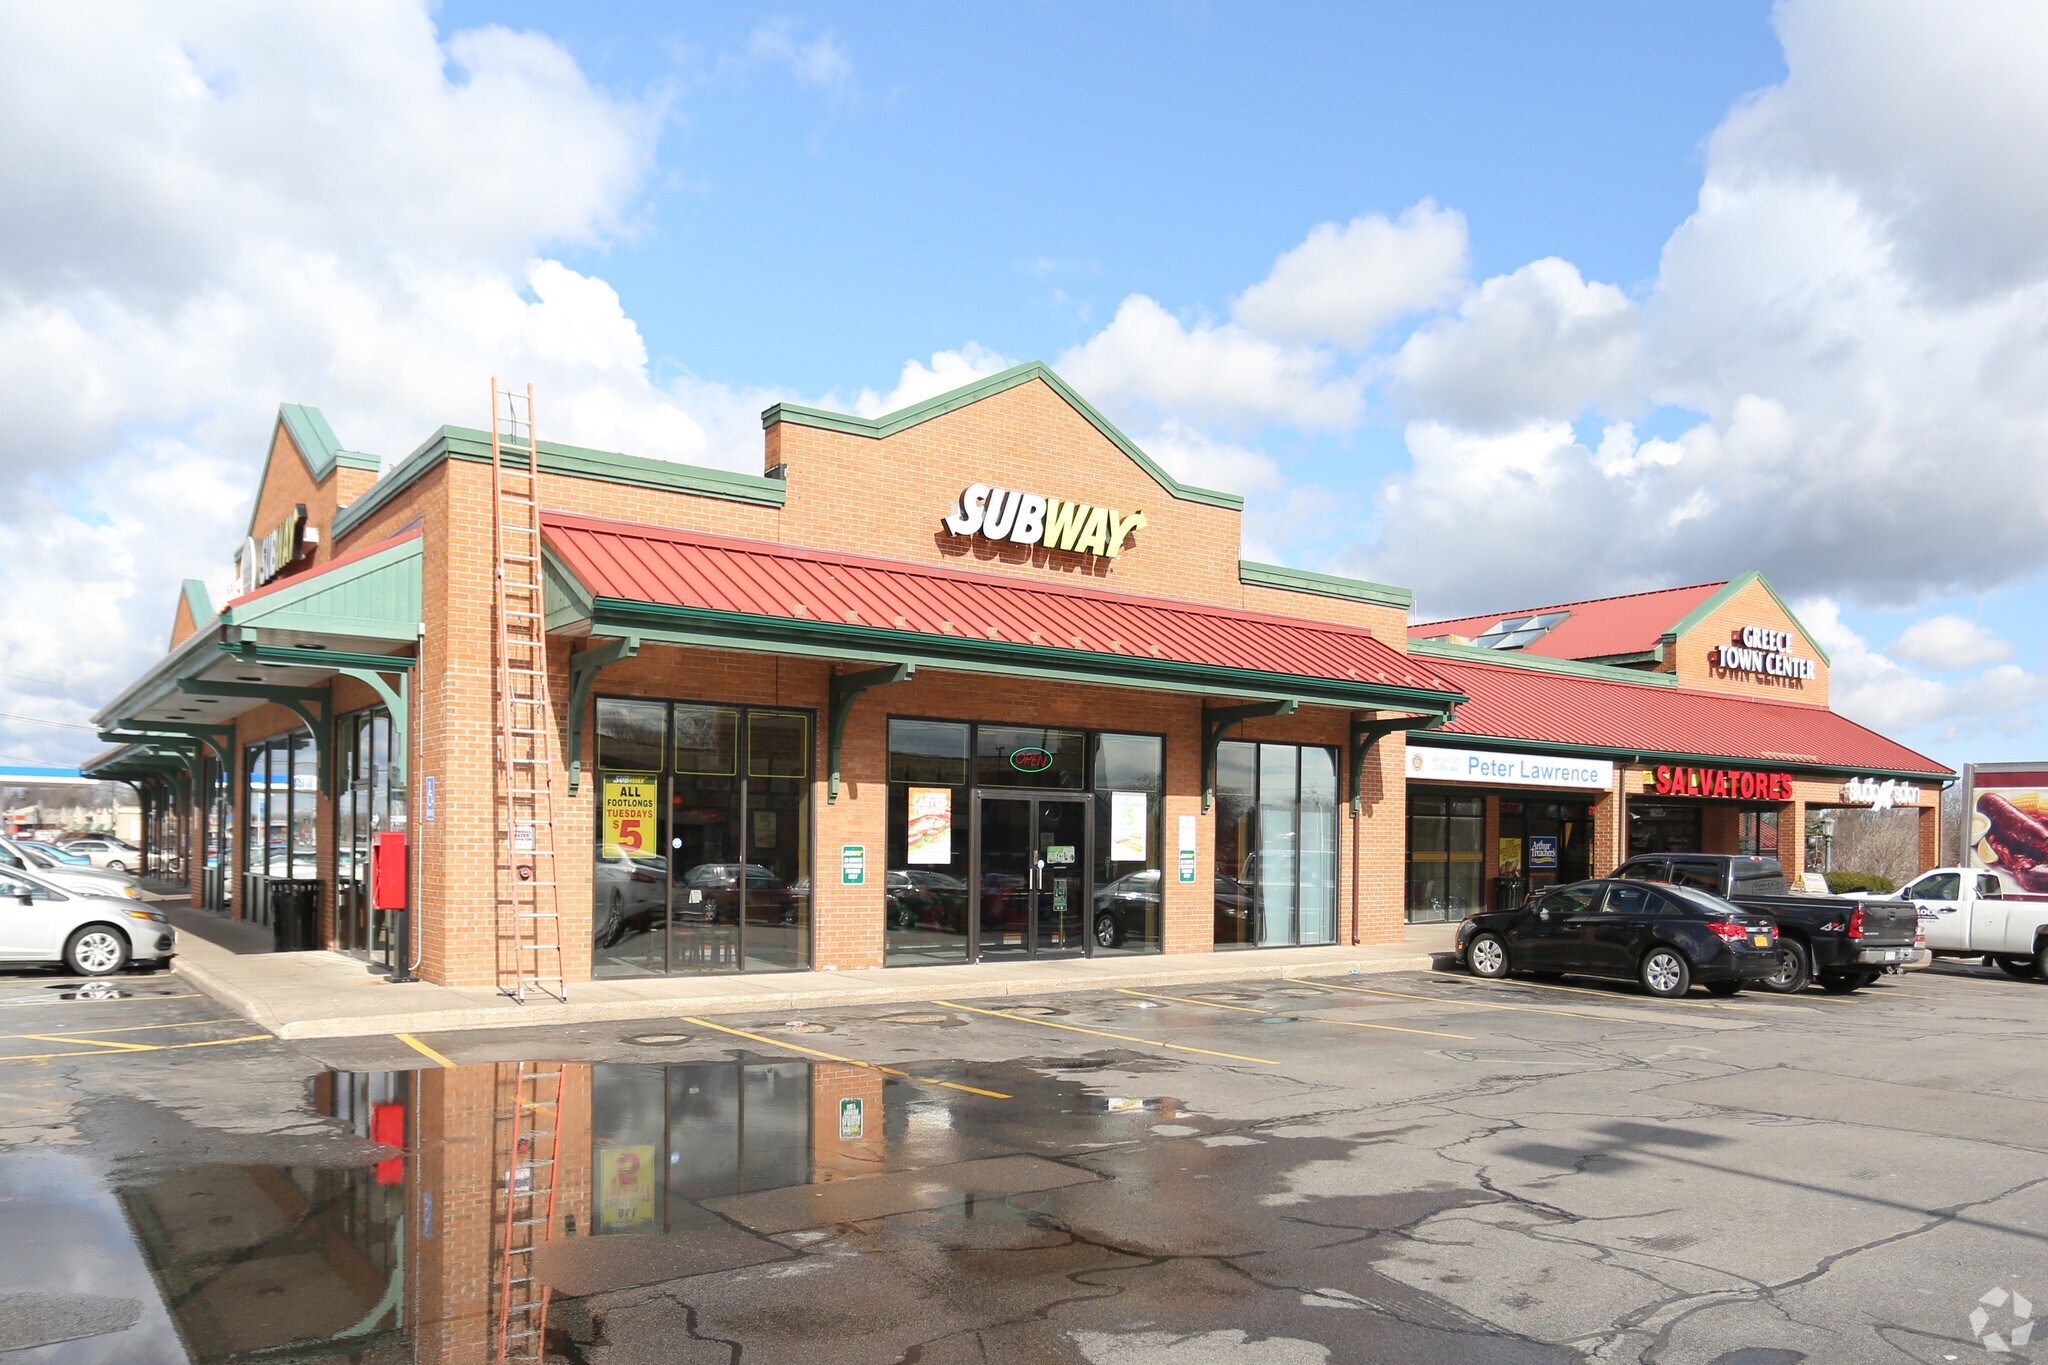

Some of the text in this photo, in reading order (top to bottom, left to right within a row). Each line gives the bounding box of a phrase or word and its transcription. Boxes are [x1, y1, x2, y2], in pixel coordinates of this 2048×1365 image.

[943, 482, 1149, 558] SUBWAY
[1742, 625, 1793, 654] GREECE
[1717, 645, 1816, 681] TOWN CENTER
[1015, 751, 1047, 768] OPEN
[1468, 756, 1599, 783] Peter Lawrence
[612, 775, 646, 784] SUBWAY
[1655, 764, 1793, 800] SALVATORE'S
[620, 786, 641, 797] ALL
[607, 798, 653, 808] FOOTLONGS
[607, 809, 653, 818] TUESDAYS
[612, 819, 643, 853] $5
[1530, 840, 1552, 851] Arthur
